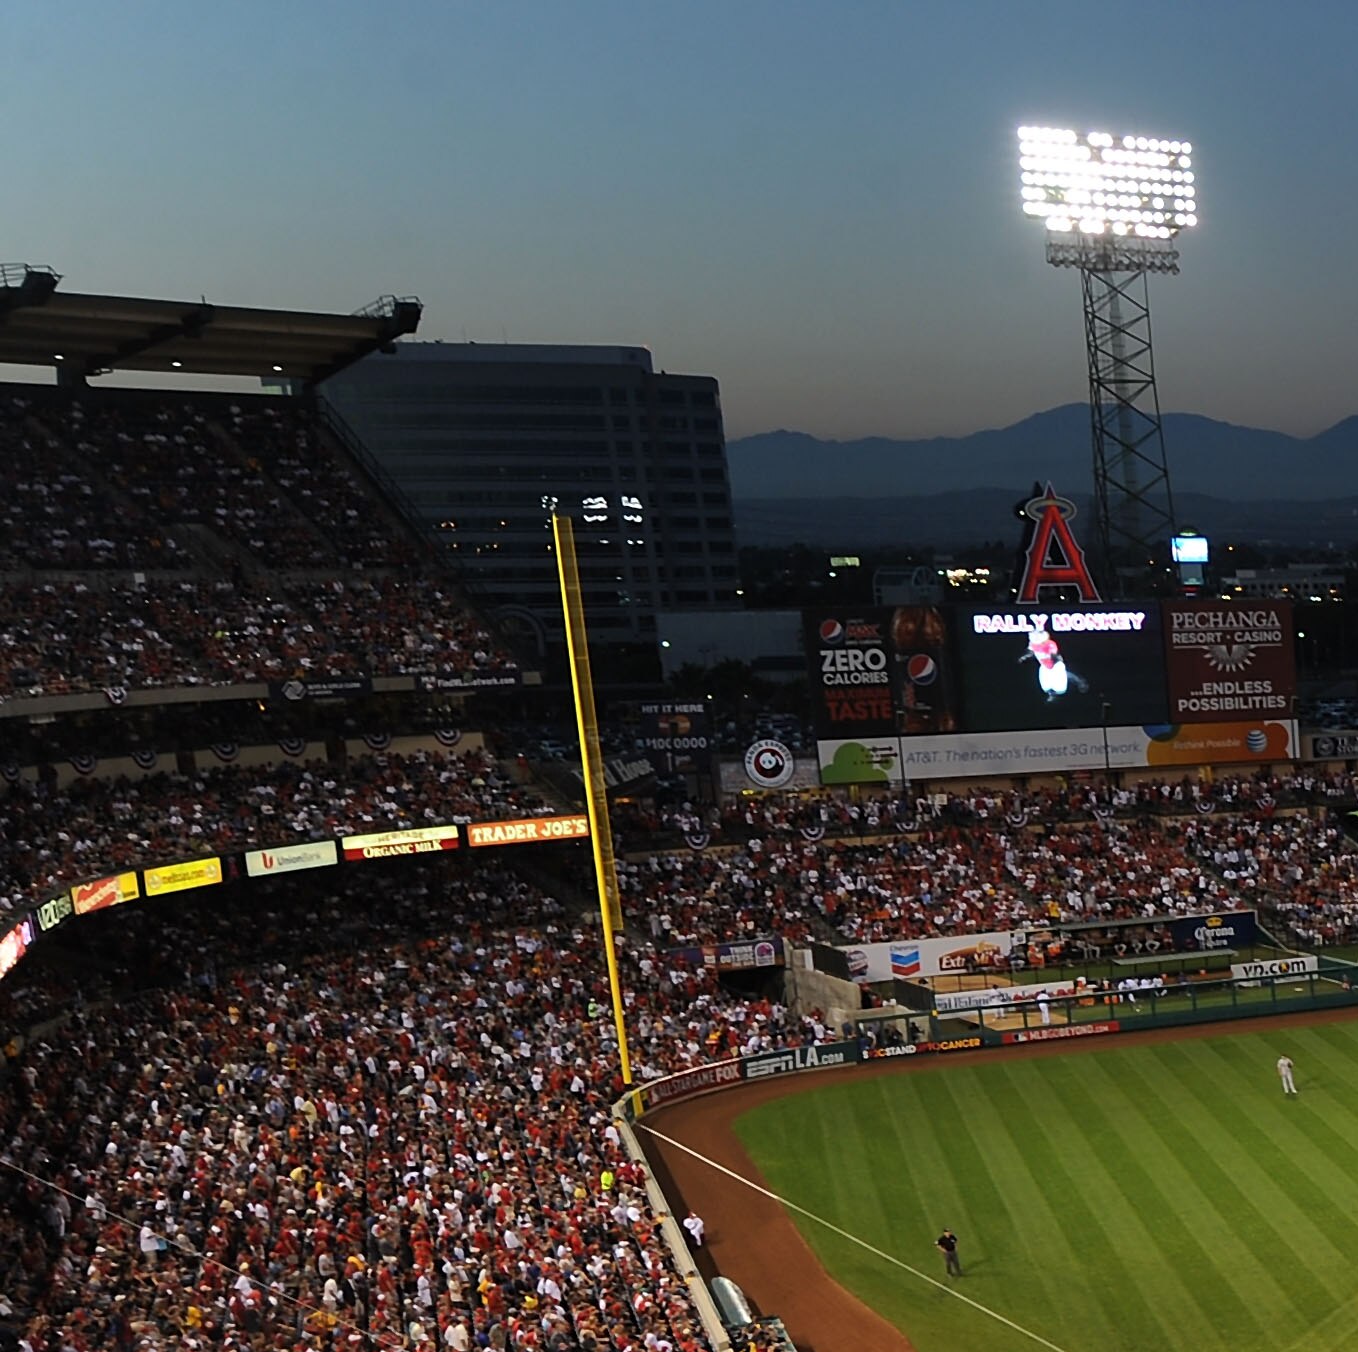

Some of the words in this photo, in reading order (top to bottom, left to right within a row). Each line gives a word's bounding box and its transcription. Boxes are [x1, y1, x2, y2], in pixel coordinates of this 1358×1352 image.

[973, 613, 1049, 633] RALLY
[1052, 611, 1146, 632] MONKEY
[1171, 611, 1281, 629] PECHANGA
[1172, 632, 1223, 644] RESORT
[1234, 630, 1282, 643] CASINO
[820, 648, 887, 672] ZERO
[823, 671, 889, 685] CALORIES
[827, 701, 893, 721] TASTE
[1178, 696, 1286, 712] POSSIBILITIES
[1024, 745, 1068, 759] fastest
[1070, 744, 1088, 757] 3G
[471, 823, 539, 843] TRADER
[541, 818, 587, 836] JOE'S
[363, 842, 414, 859] ORGANIC
[415, 838, 443, 853] MILK
[940, 1037, 981, 1050] CANCER
[693, 1070, 717, 1087] GAME
[716, 1063, 740, 1082] FOX
